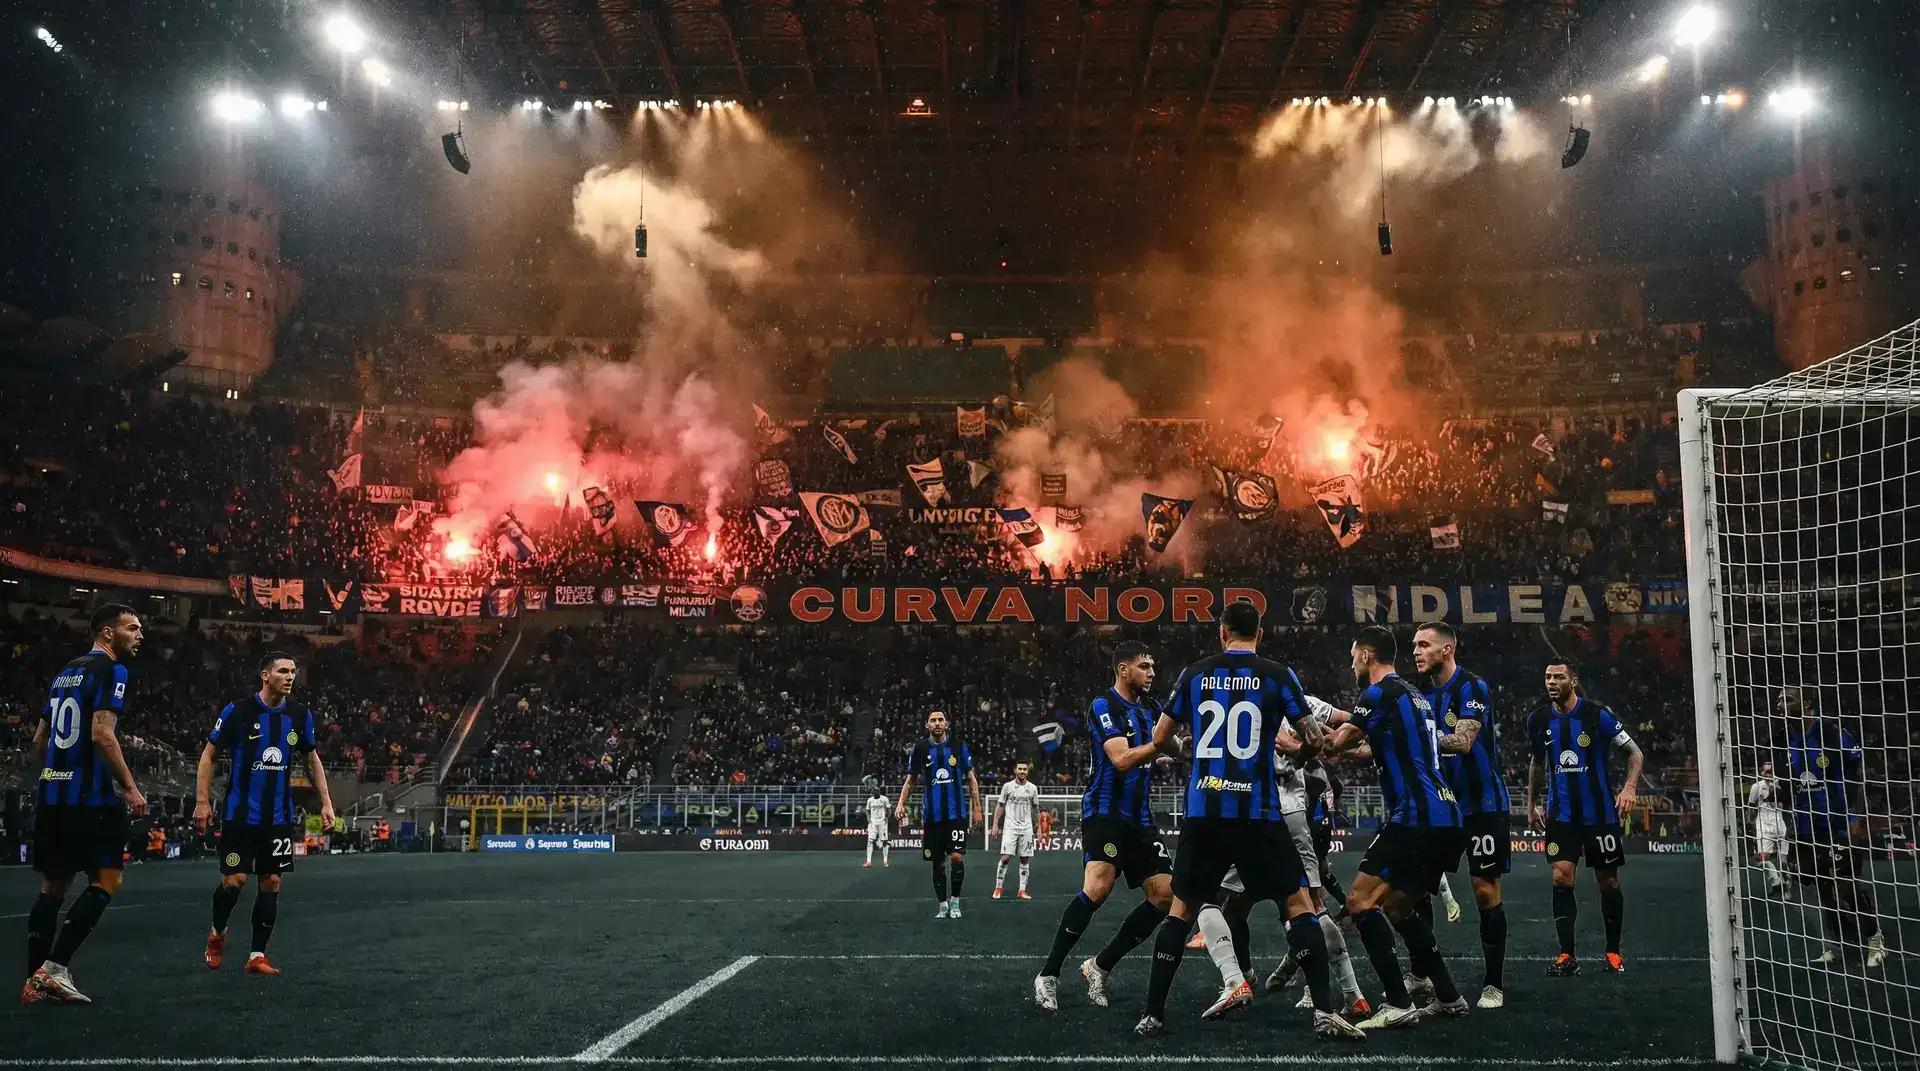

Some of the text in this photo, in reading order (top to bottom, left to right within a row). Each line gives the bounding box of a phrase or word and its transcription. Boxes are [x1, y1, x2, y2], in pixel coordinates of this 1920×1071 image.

[669, 606, 706, 617] MILAN
[790, 587, 1267, 622] CURVA NORD
[50, 697, 80, 749] 10
[1196, 700, 1262, 760] 20
[272, 838, 292, 857] 22
[1471, 834, 1495, 857] 20
[1596, 834, 1617, 853] 10
